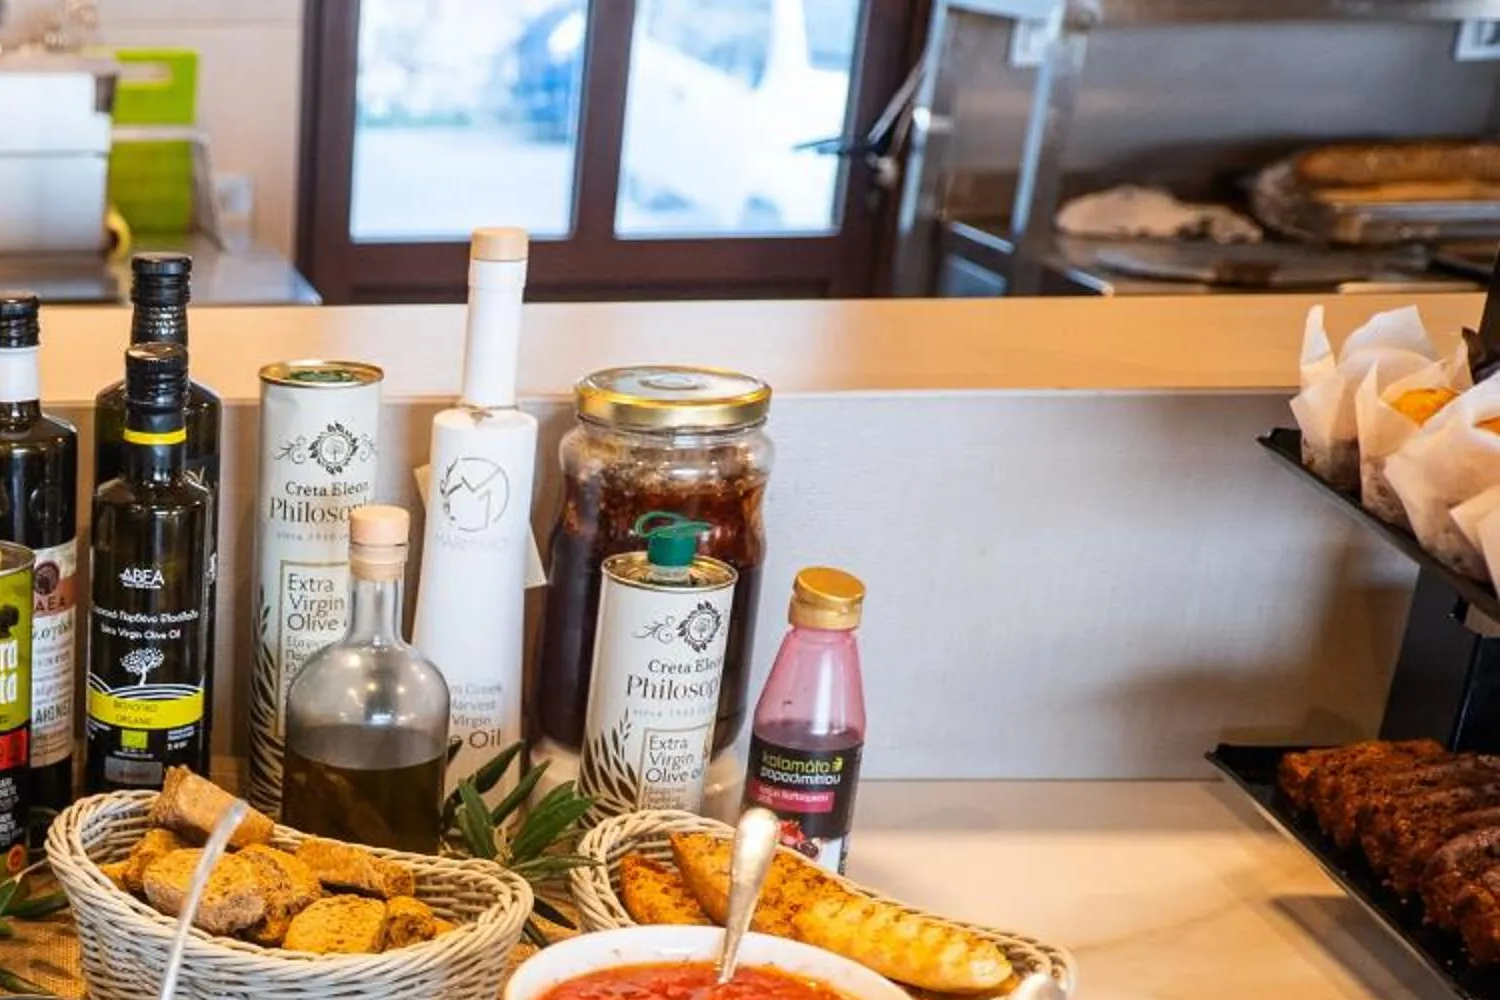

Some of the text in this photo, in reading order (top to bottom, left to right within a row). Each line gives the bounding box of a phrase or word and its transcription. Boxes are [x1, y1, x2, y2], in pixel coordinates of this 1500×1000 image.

[285, 481, 328, 497] Creta
[120, 567, 165, 585] ABEA
[288, 573, 334, 592] Extra
[290, 593, 344, 618] Virgin
[288, 614, 339, 631] Olive
[648, 659, 691, 674] Creta
[469, 728, 500, 748] Oil
[649, 735, 688, 751] Extra
[649, 751, 694, 771] Virgin
[646, 768, 688, 783] Olive
